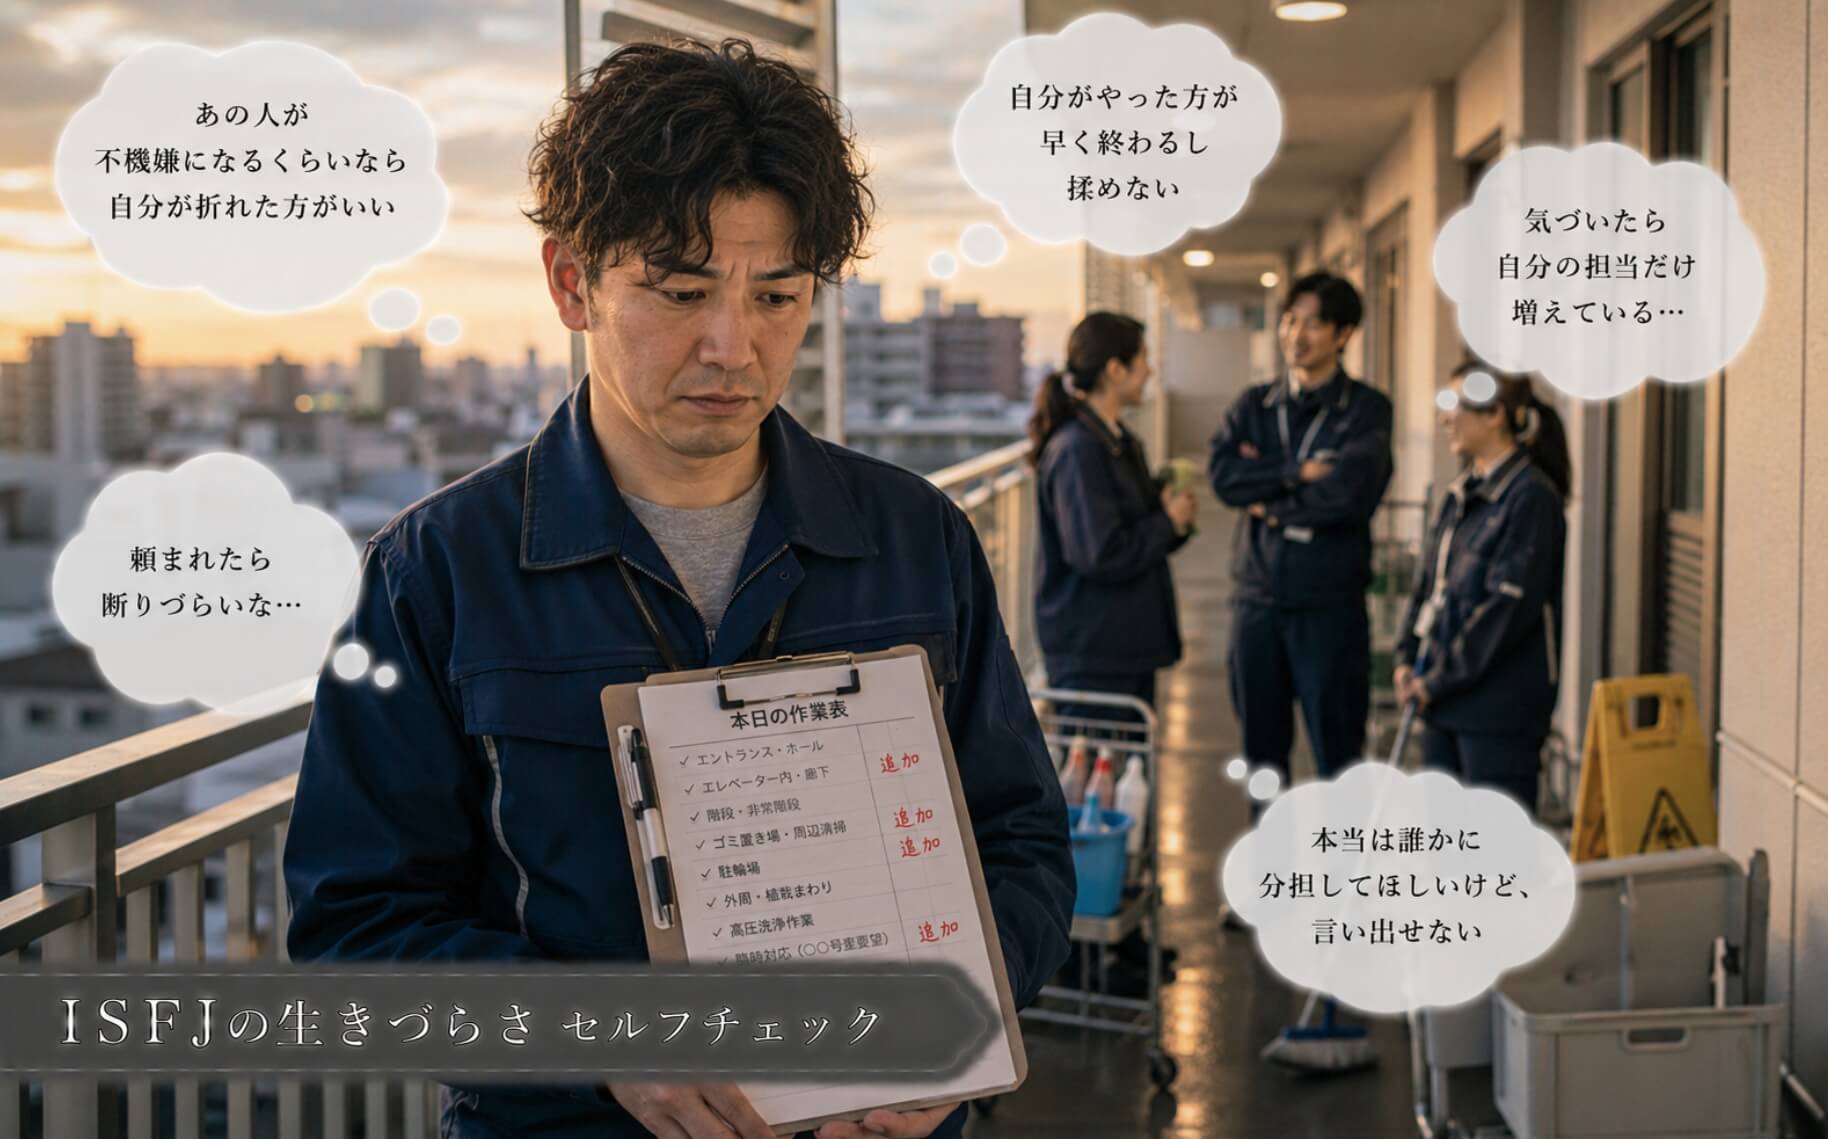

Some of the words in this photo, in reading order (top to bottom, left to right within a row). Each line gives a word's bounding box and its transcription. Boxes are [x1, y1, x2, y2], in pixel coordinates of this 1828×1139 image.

[729, 700, 849, 730] 本日の作業表
[697, 741, 825, 766] エントランス・ホール
[880, 753, 919, 773] 追加
[894, 807, 933, 828] 追加
[900, 836, 941, 858] 追加
[918, 920, 959, 943] 追加
